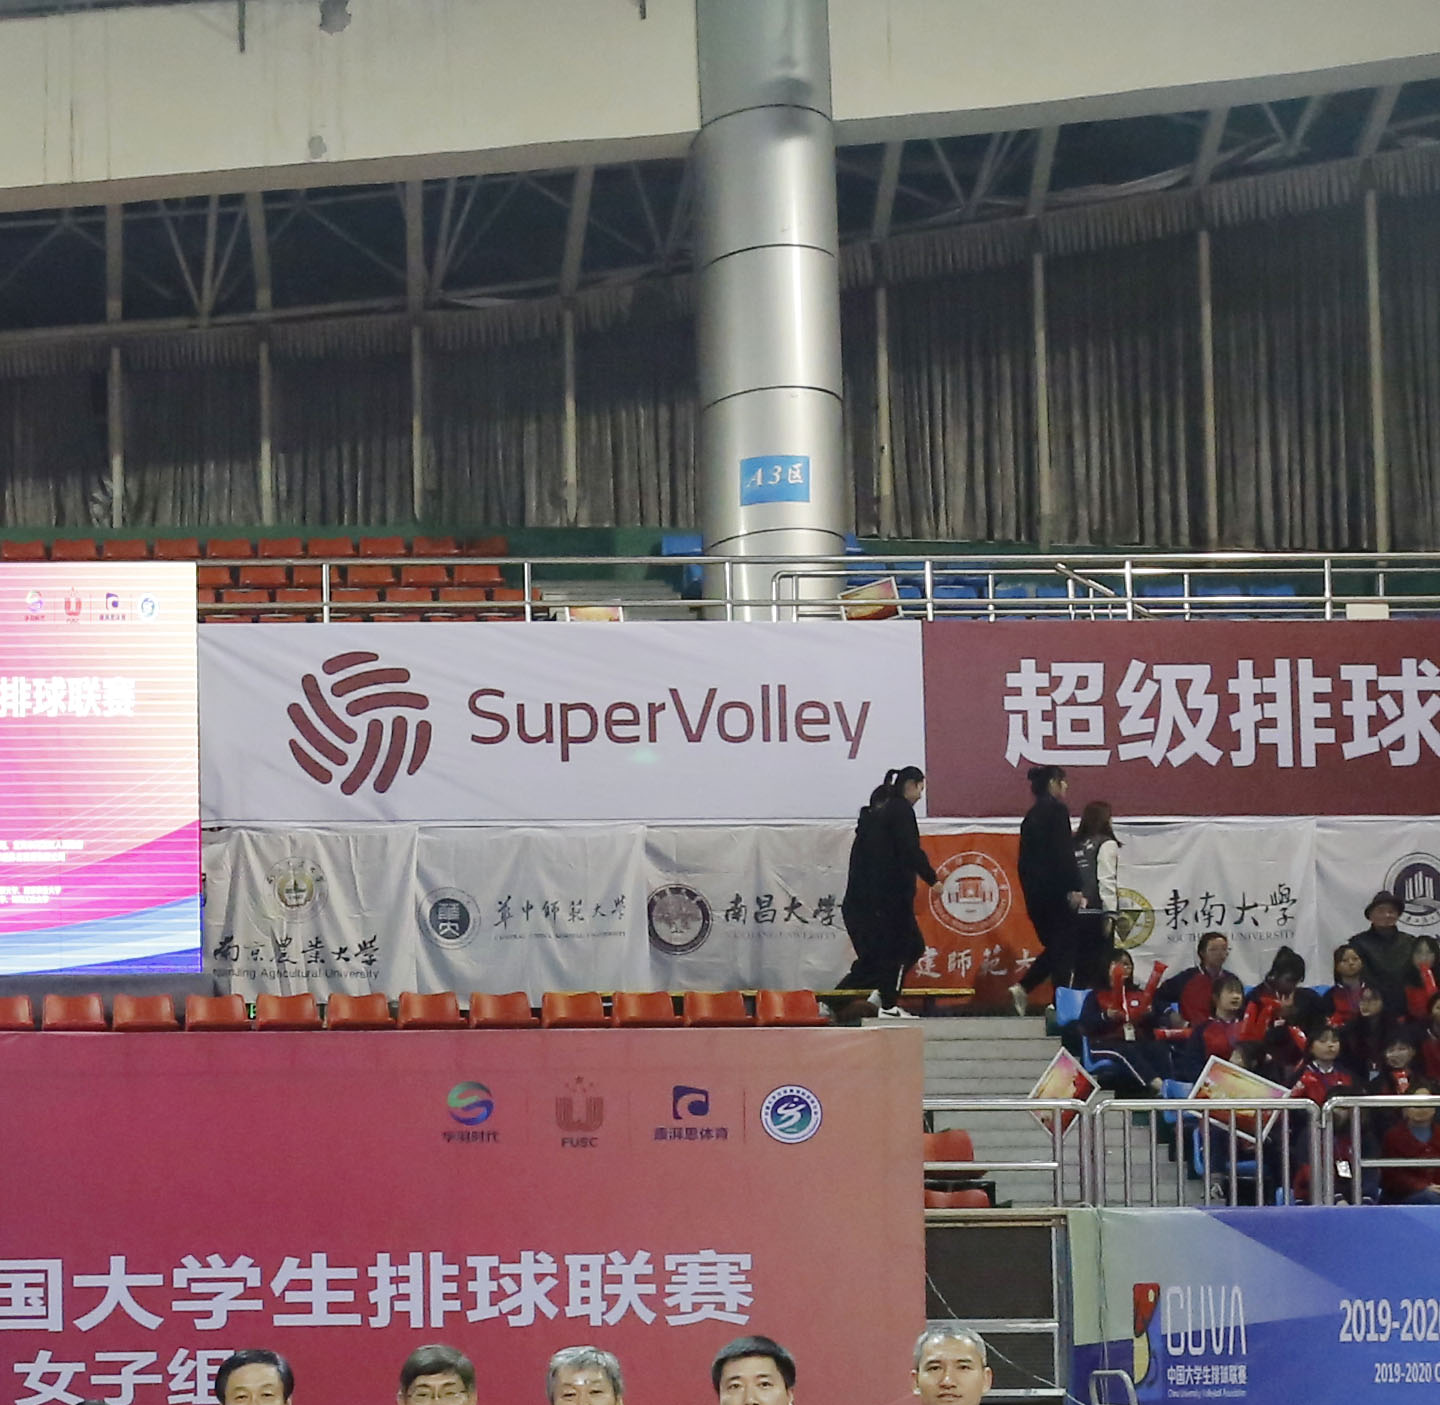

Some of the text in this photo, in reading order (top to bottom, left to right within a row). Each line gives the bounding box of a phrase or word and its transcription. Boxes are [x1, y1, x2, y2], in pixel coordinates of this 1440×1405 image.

[467, 684, 872, 761] SuperVolley
[1231, 931, 1296, 944] UNIVERSITY
[324, 968, 380, 979] University
[561, 1137, 600, 1148] FUSC
[1166, 1285, 1247, 1356] CUVA
[1167, 1365, 1248, 1385] 中国大学生排球联赛
[1374, 1362, 1431, 1384] 2019-2020
